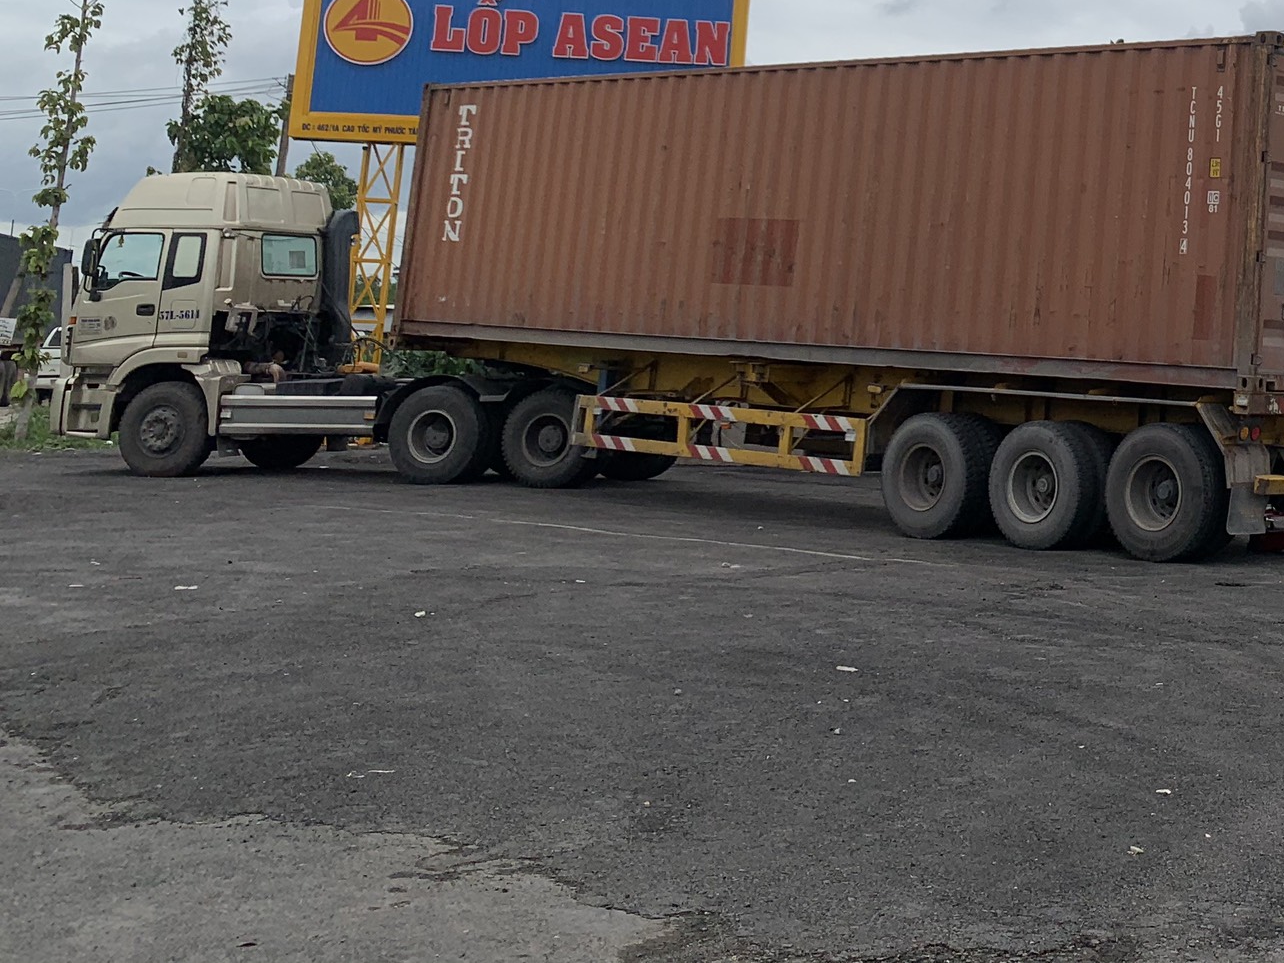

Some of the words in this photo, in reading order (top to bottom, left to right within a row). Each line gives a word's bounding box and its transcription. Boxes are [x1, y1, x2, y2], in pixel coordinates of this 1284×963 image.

[552, 12, 731, 66] ASEAN
[1188, 86, 1197, 143] TCNU
[1215, 86, 1223, 143] 45G1
[442, 104, 477, 242] TRITON
[1182, 147, 1193, 235] 804013
[1179, 238, 1188, 254] 4
